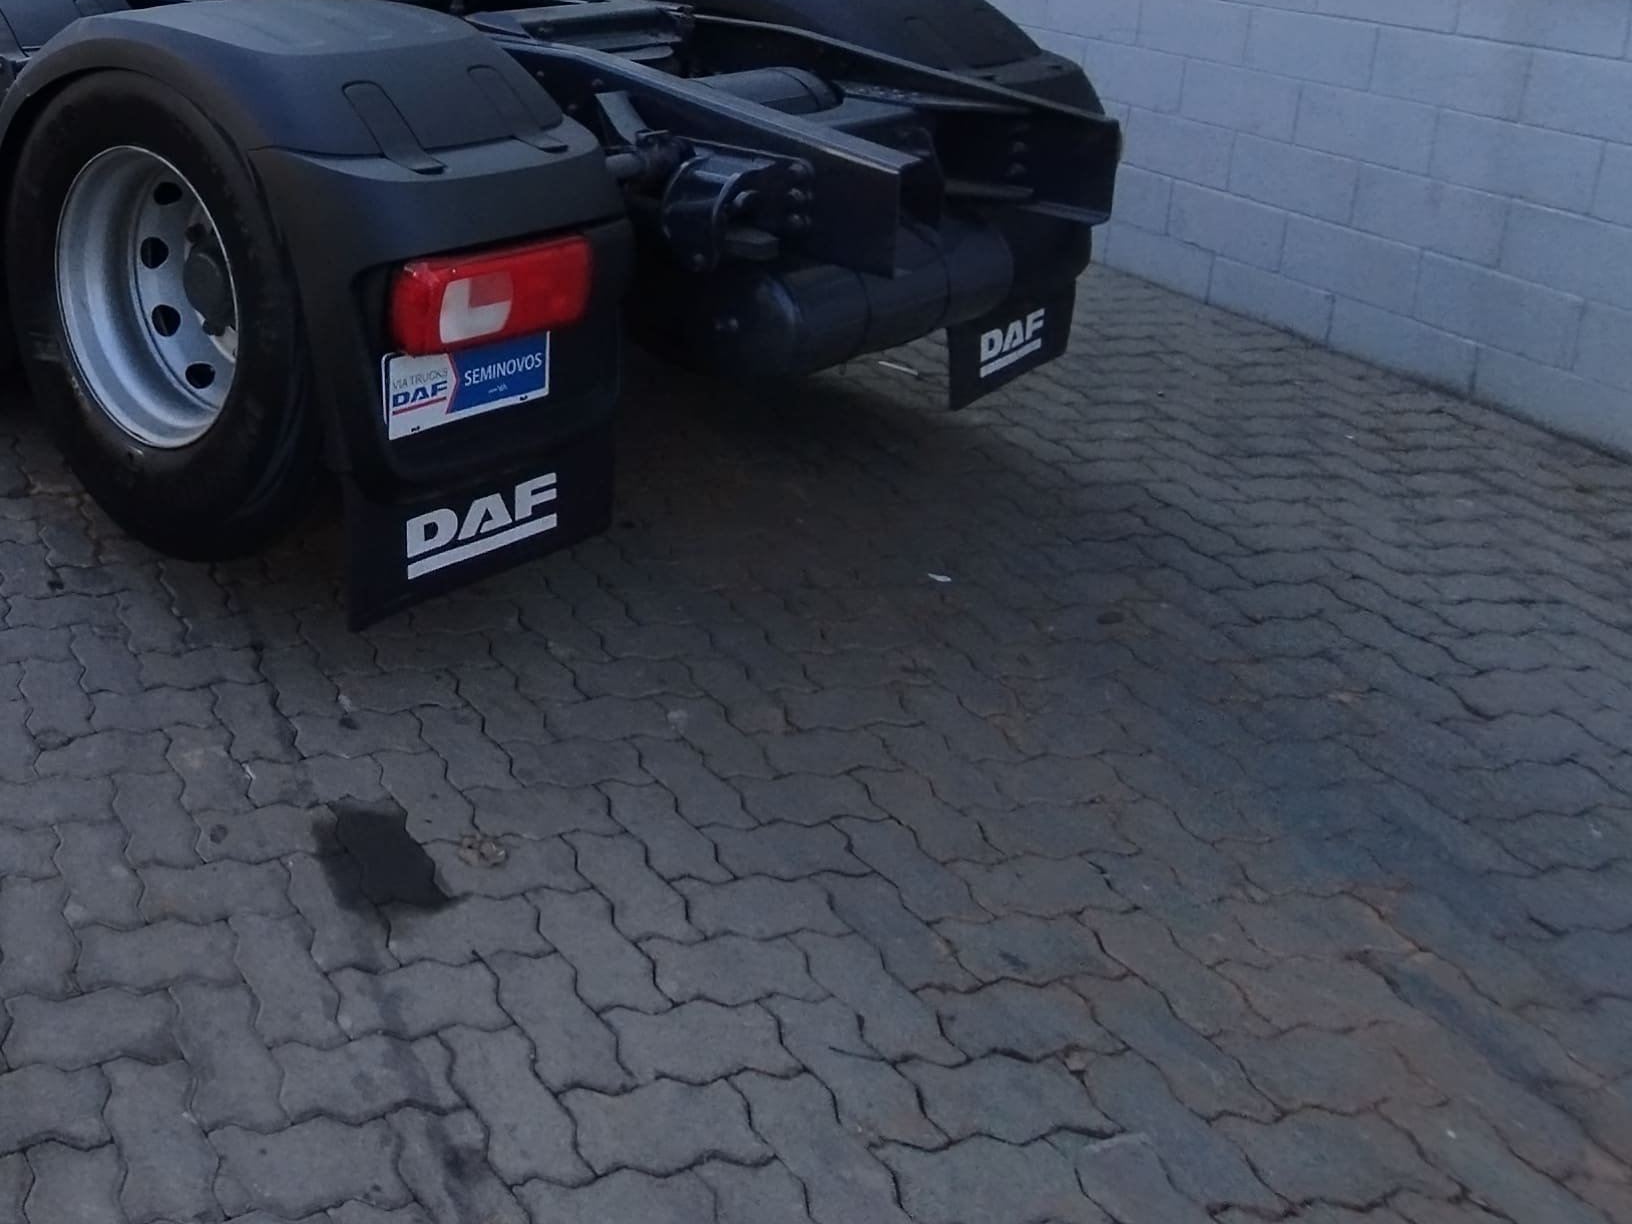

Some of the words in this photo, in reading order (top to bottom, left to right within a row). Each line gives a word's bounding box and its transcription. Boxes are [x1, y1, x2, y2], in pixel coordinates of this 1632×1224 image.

[980, 308, 1046, 363] DAF
[392, 379, 409, 390] VIA
[411, 368, 448, 385] TRUCKS
[464, 352, 543, 387] SEMINOVOS
[392, 380, 448, 408] DAF
[406, 472, 557, 559] DAF
